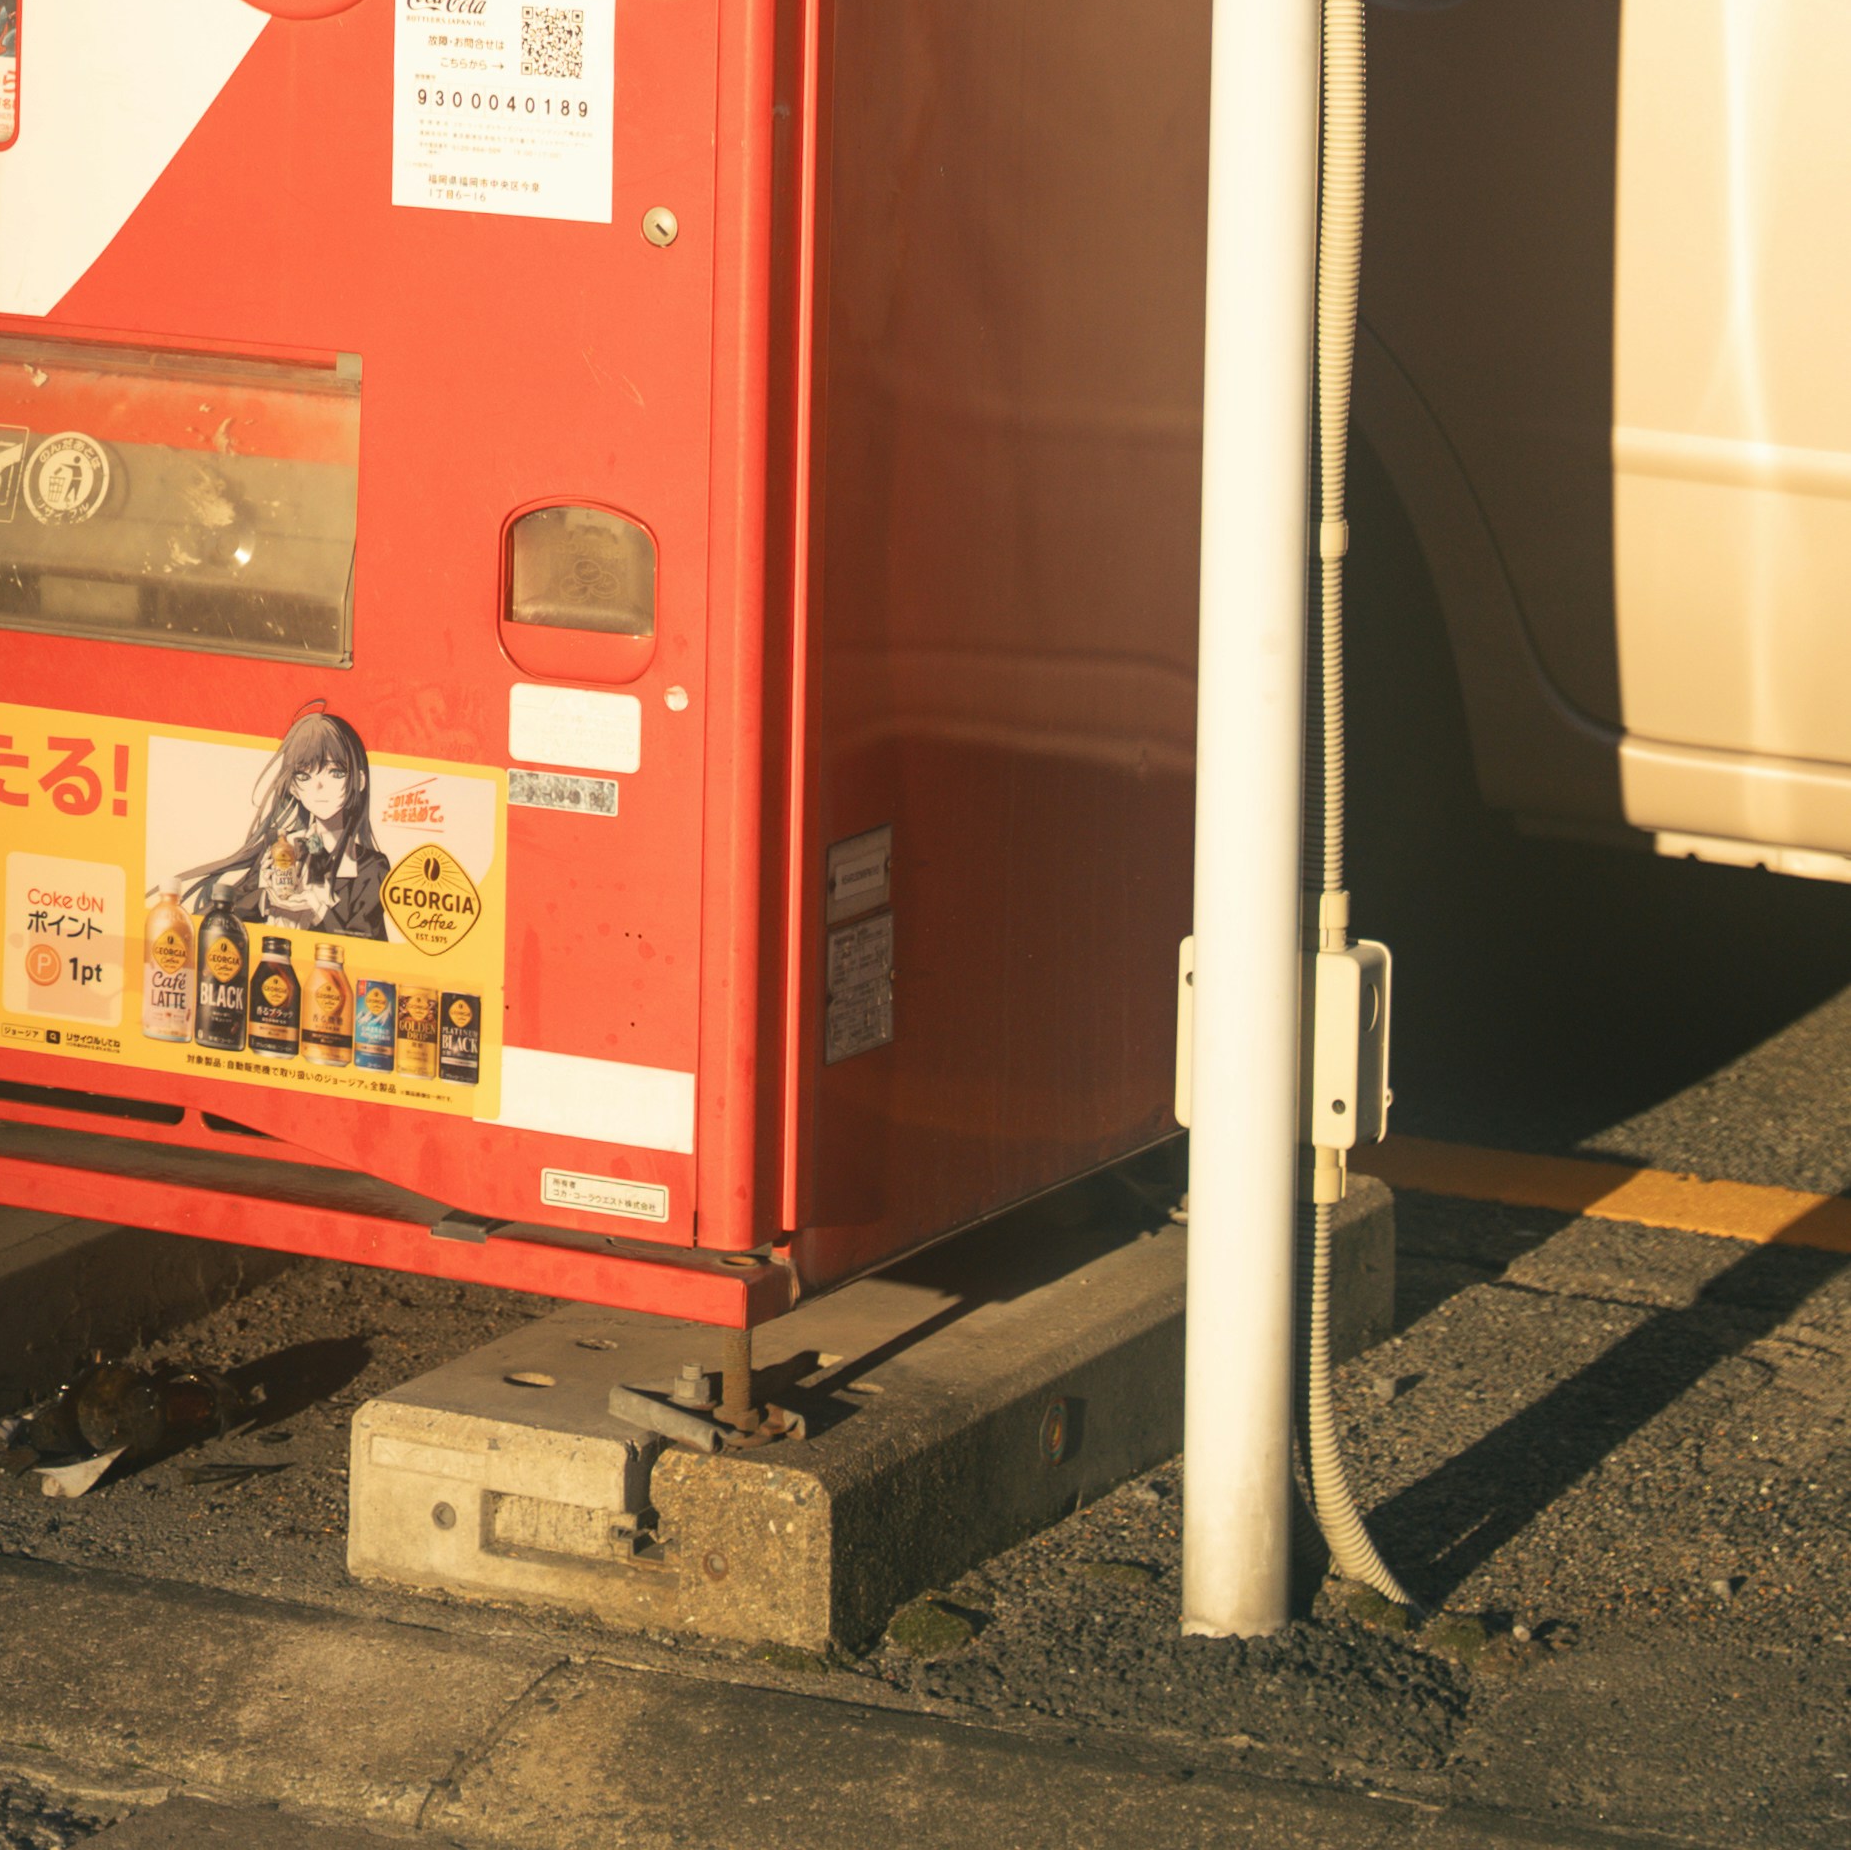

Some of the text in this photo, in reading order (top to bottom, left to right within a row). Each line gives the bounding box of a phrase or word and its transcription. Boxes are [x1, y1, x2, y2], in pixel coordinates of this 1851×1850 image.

[440, 57, 488, 69] こちらから
[428, 174, 540, 192] 福岡県福岡市中央区今泉
[27, 887, 73, 910] Coke
[388, 885, 475, 916] GEORGIA
[27, 910, 104, 940] ポイント
[406, 910, 457, 932] Coffee
[67, 958, 103, 985] 1pt
[152, 970, 188, 992] Café
[151, 989, 187, 1010] LATTE
[199, 983, 245, 1010] BLACK
[4, 1025, 40, 1040] ジョージア
